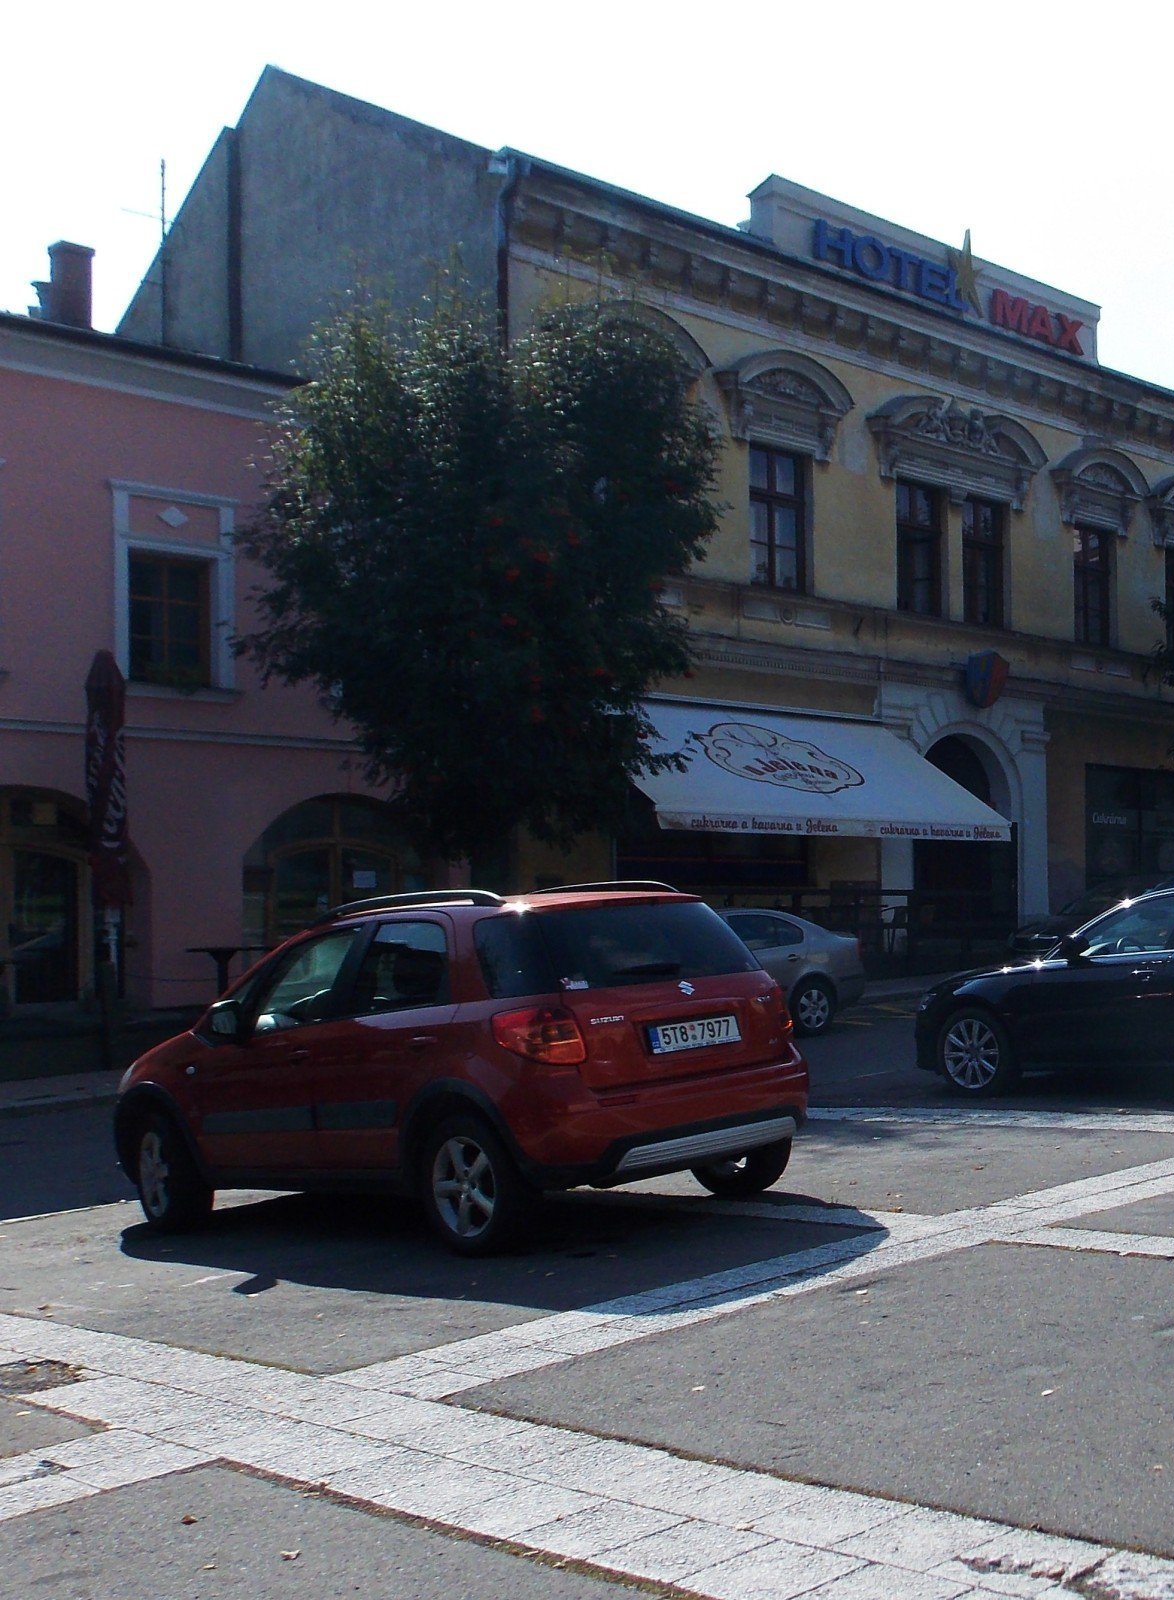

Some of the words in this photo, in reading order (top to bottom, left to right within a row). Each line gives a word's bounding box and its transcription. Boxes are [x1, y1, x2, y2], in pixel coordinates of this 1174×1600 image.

[814, 218, 968, 310] HOTEL
[991, 288, 1084, 355] MAX
[805, 819, 838, 833] Jelena
[590, 1015, 624, 1025] SUZUKI
[661, 1025, 689, 1045] 5T8
[697, 1019, 730, 1039] 7977
